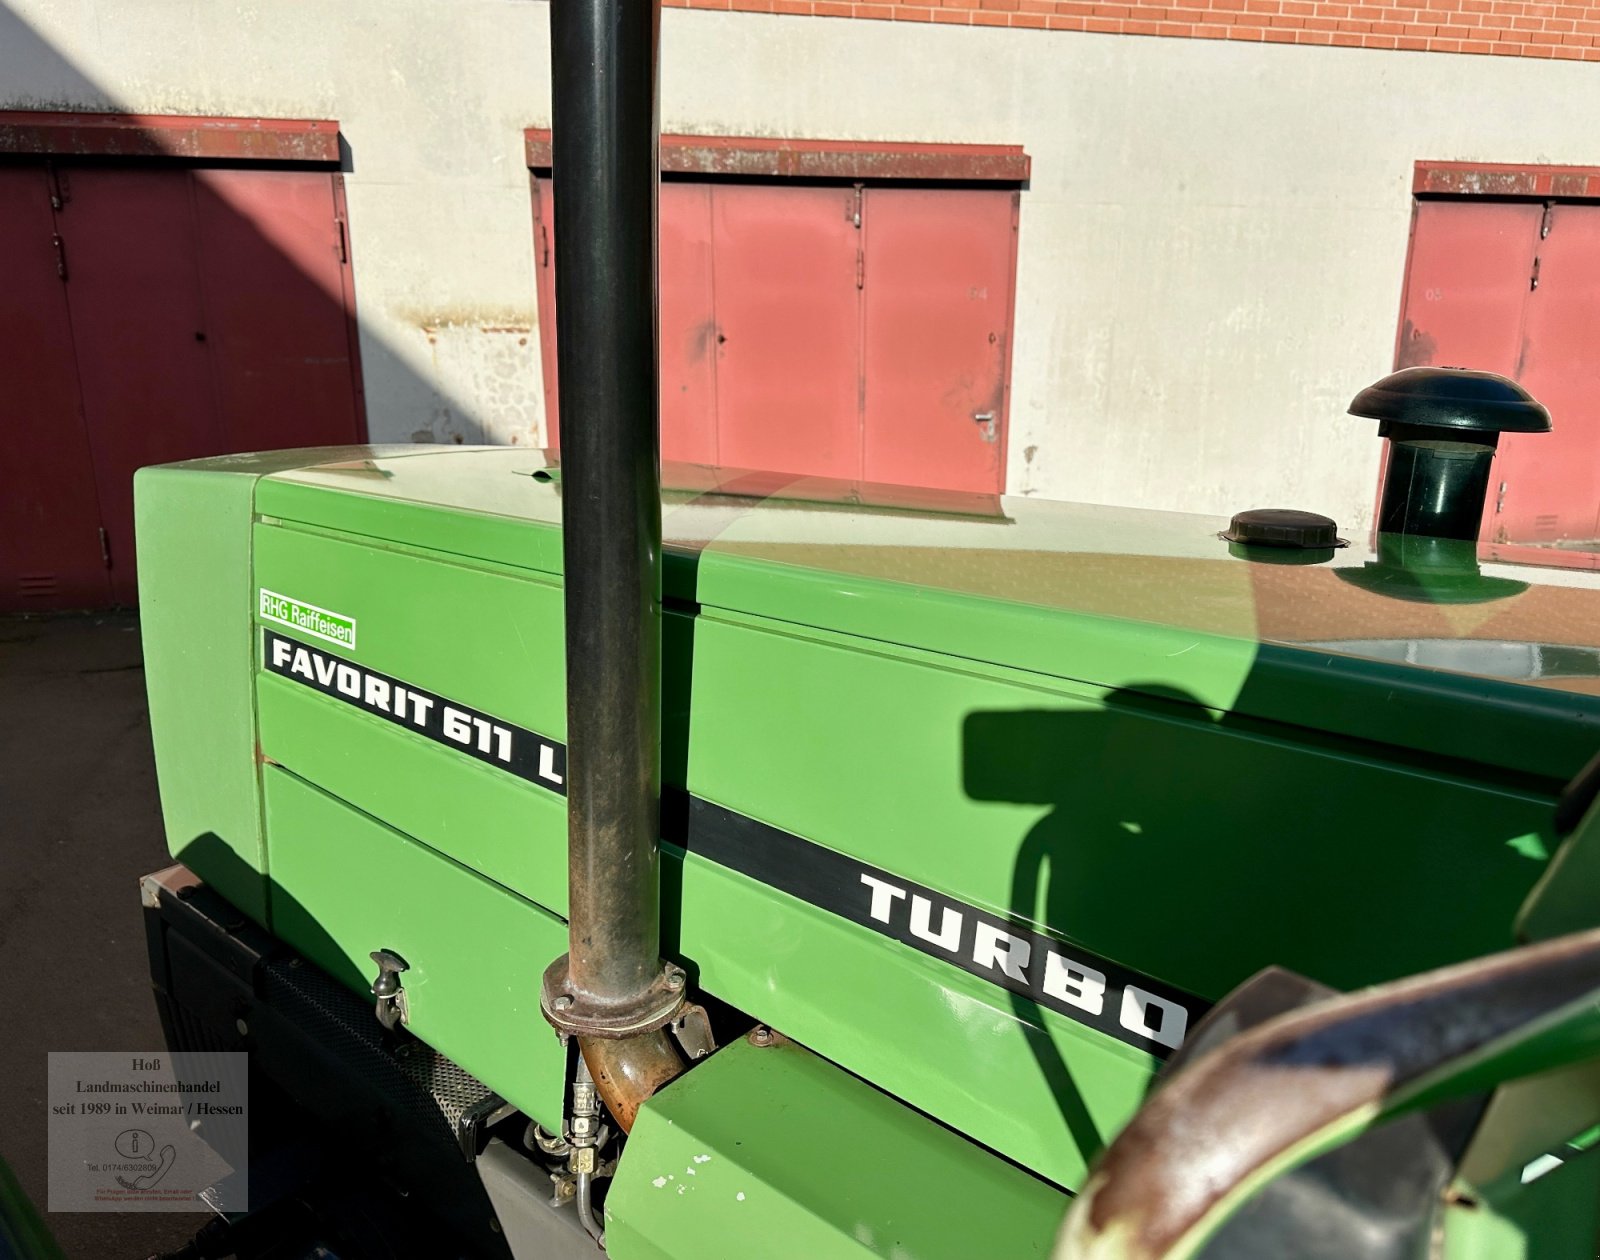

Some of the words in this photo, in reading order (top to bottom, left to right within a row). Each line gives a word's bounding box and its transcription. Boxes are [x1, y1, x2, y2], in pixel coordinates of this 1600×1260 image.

[263, 593, 288, 621] RHG
[291, 605, 353, 643] Raiffeisen
[273, 638, 434, 727] FAVORIT
[443, 706, 512, 763] 611
[539, 744, 563, 785] L
[860, 873, 1189, 1050] TURBO
